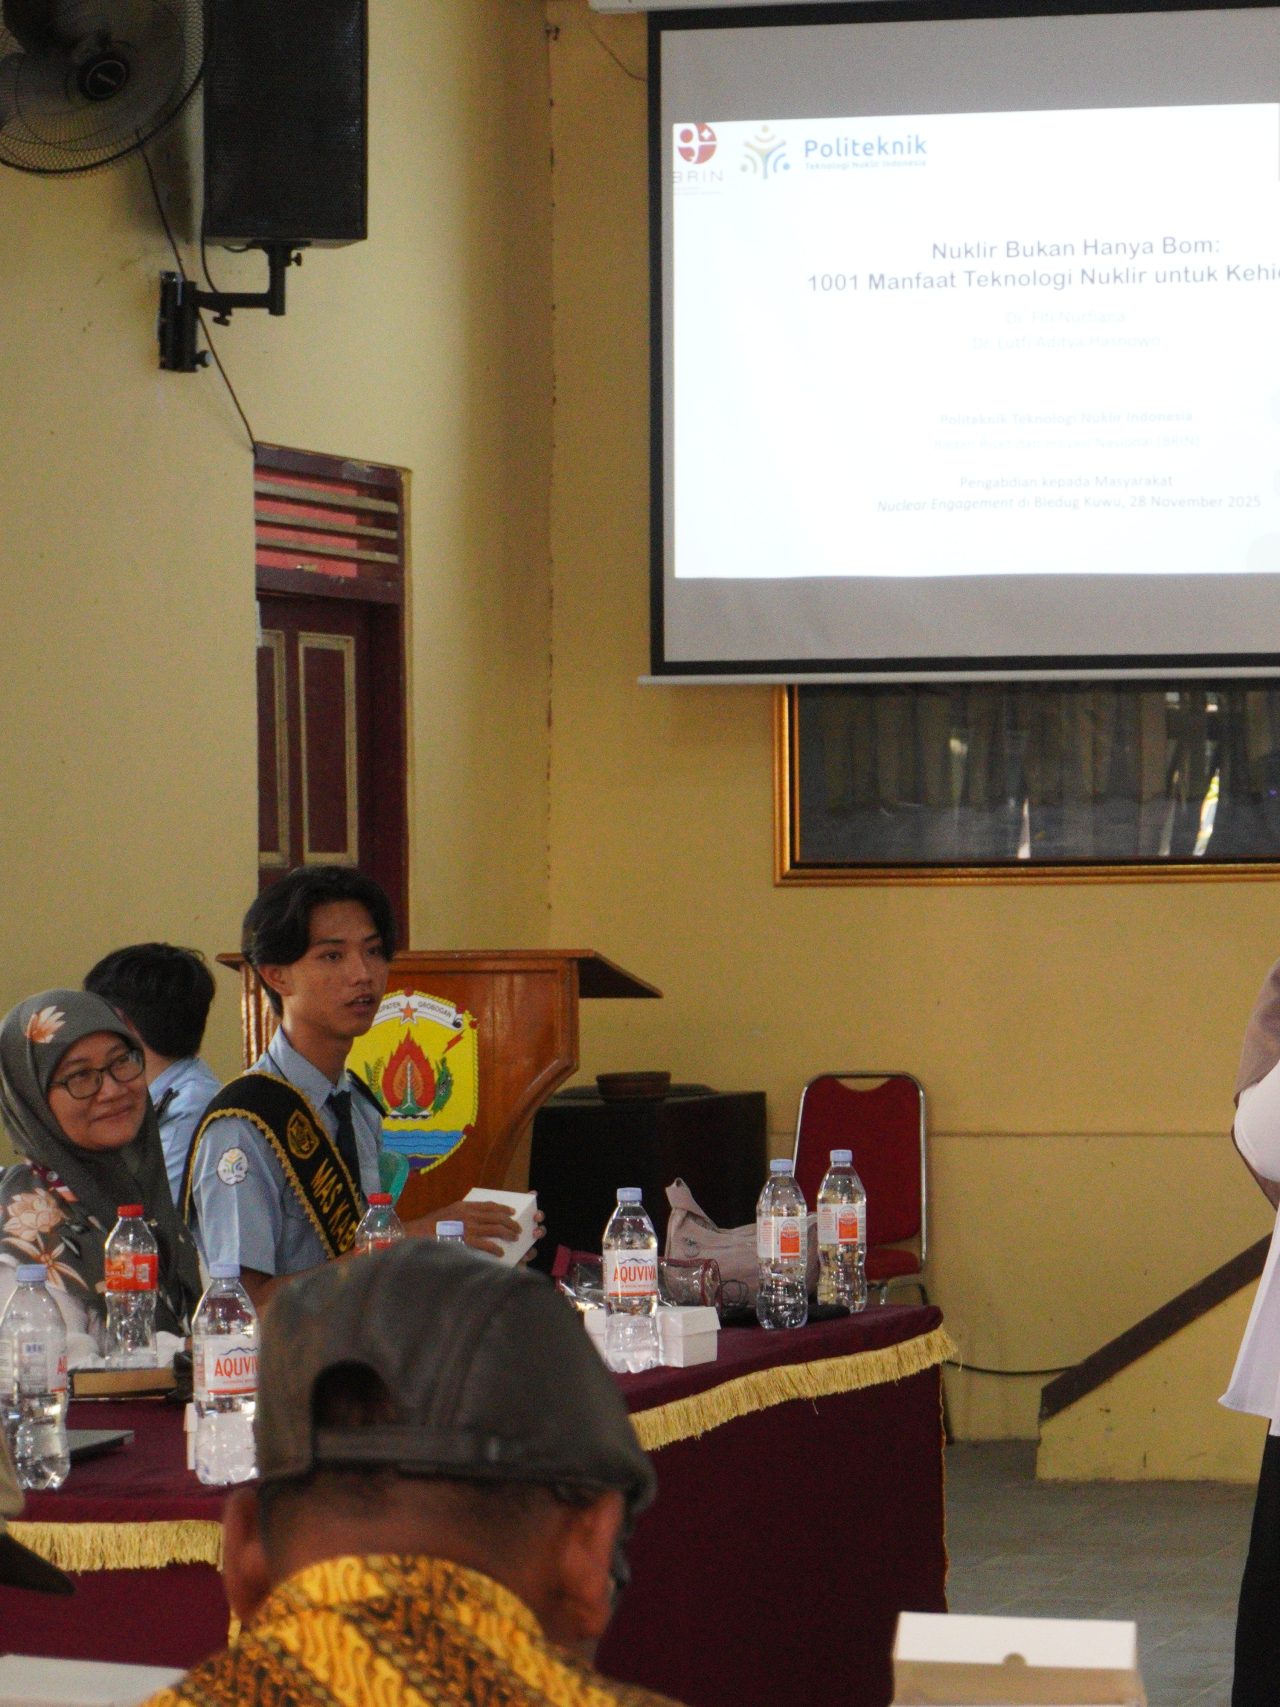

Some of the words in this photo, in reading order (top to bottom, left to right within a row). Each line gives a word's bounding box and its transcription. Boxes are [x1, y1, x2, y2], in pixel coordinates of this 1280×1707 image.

[805, 135, 928, 158] Politeknik
[932, 241, 998, 260] Nuklir
[1006, 239, 1075, 258] Bukan
[1083, 238, 1154, 260] Hanya
[1163, 236, 1220, 255] Bom:
[808, 273, 858, 291] 1001
[868, 271, 957, 291] Manfaat
[963, 268, 1072, 291] Teknologi
[1081, 266, 1147, 285] Nuklir
[1155, 265, 1218, 284] untuk
[940, 412, 1008, 425] Politeknik
[1011, 411, 1077, 427] Teknologi
[1127, 410, 1193, 423] Indonesia
[960, 476, 1037, 491] Pengabdian
[1041, 476, 1090, 490] kepada
[1095, 475, 1173, 488] Masyarakat
[877, 499, 927, 512] Nuclear
[931, 498, 1014, 512] Engagement
[1018, 497, 1030, 508] di
[1035, 496, 1080, 511] Bledug
[1130, 496, 1146, 507] 28
[1151, 496, 1223, 508] November
[1228, 496, 1262, 508] 2025
[310, 1158, 343, 1214] MAS
[214, 1356, 257, 1378] AQUVI
